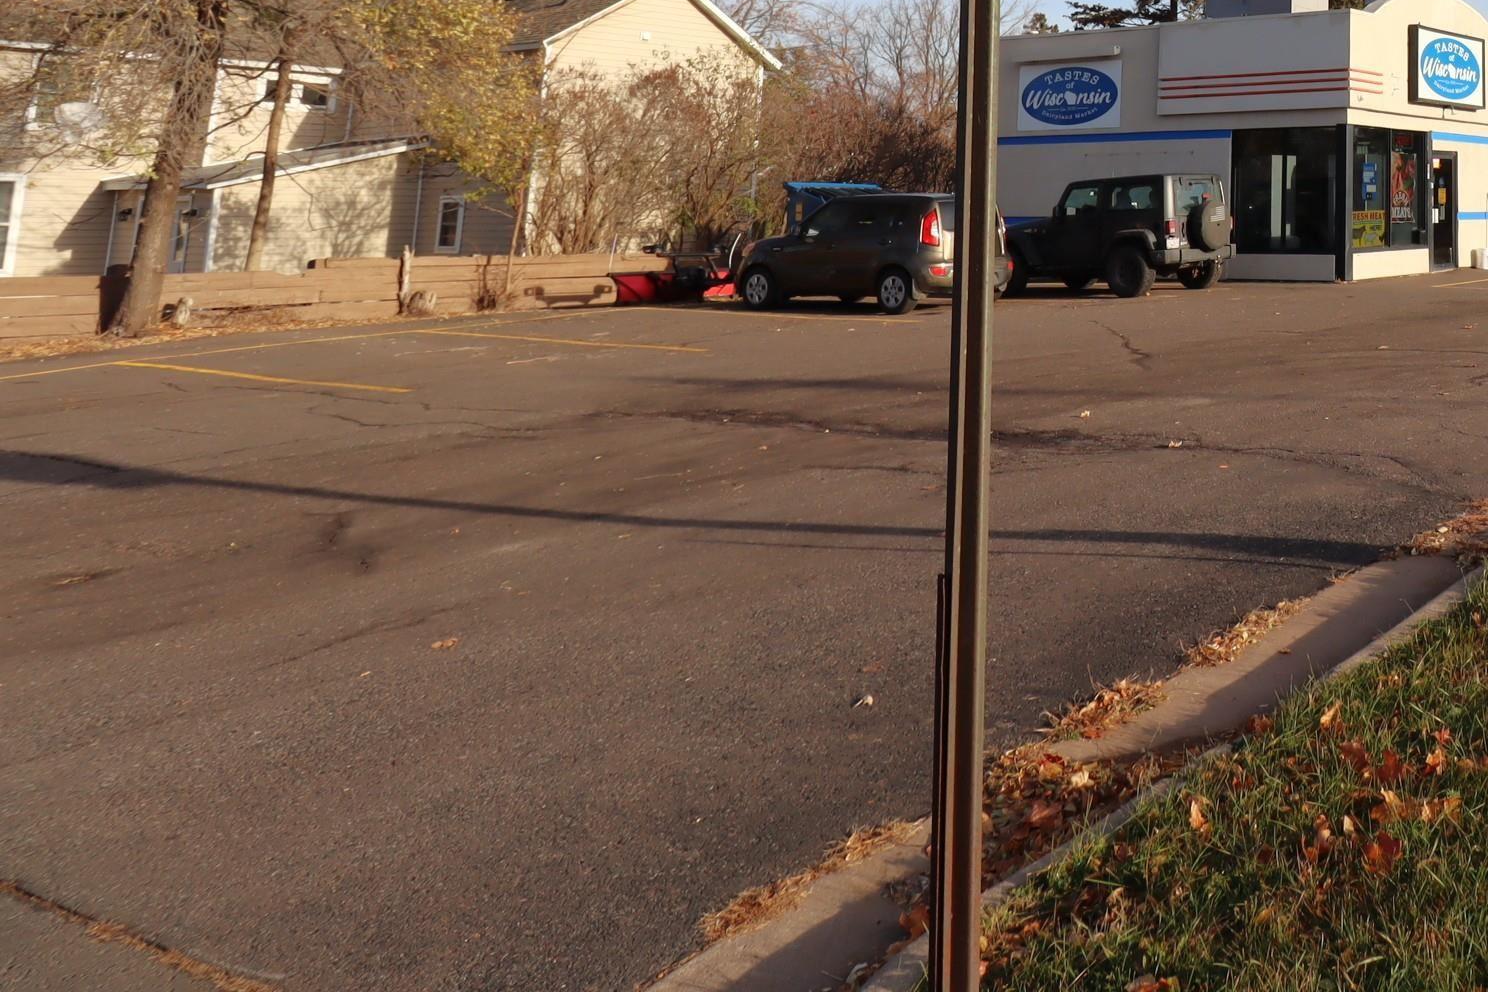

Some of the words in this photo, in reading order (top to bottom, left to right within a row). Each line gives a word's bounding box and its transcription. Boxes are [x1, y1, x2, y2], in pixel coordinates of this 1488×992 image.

[1434, 41, 1470, 62] TASTES
[1448, 54, 1455, 62] of
[1044, 70, 1100, 85] TASTES
[1065, 81, 1075, 89] of
